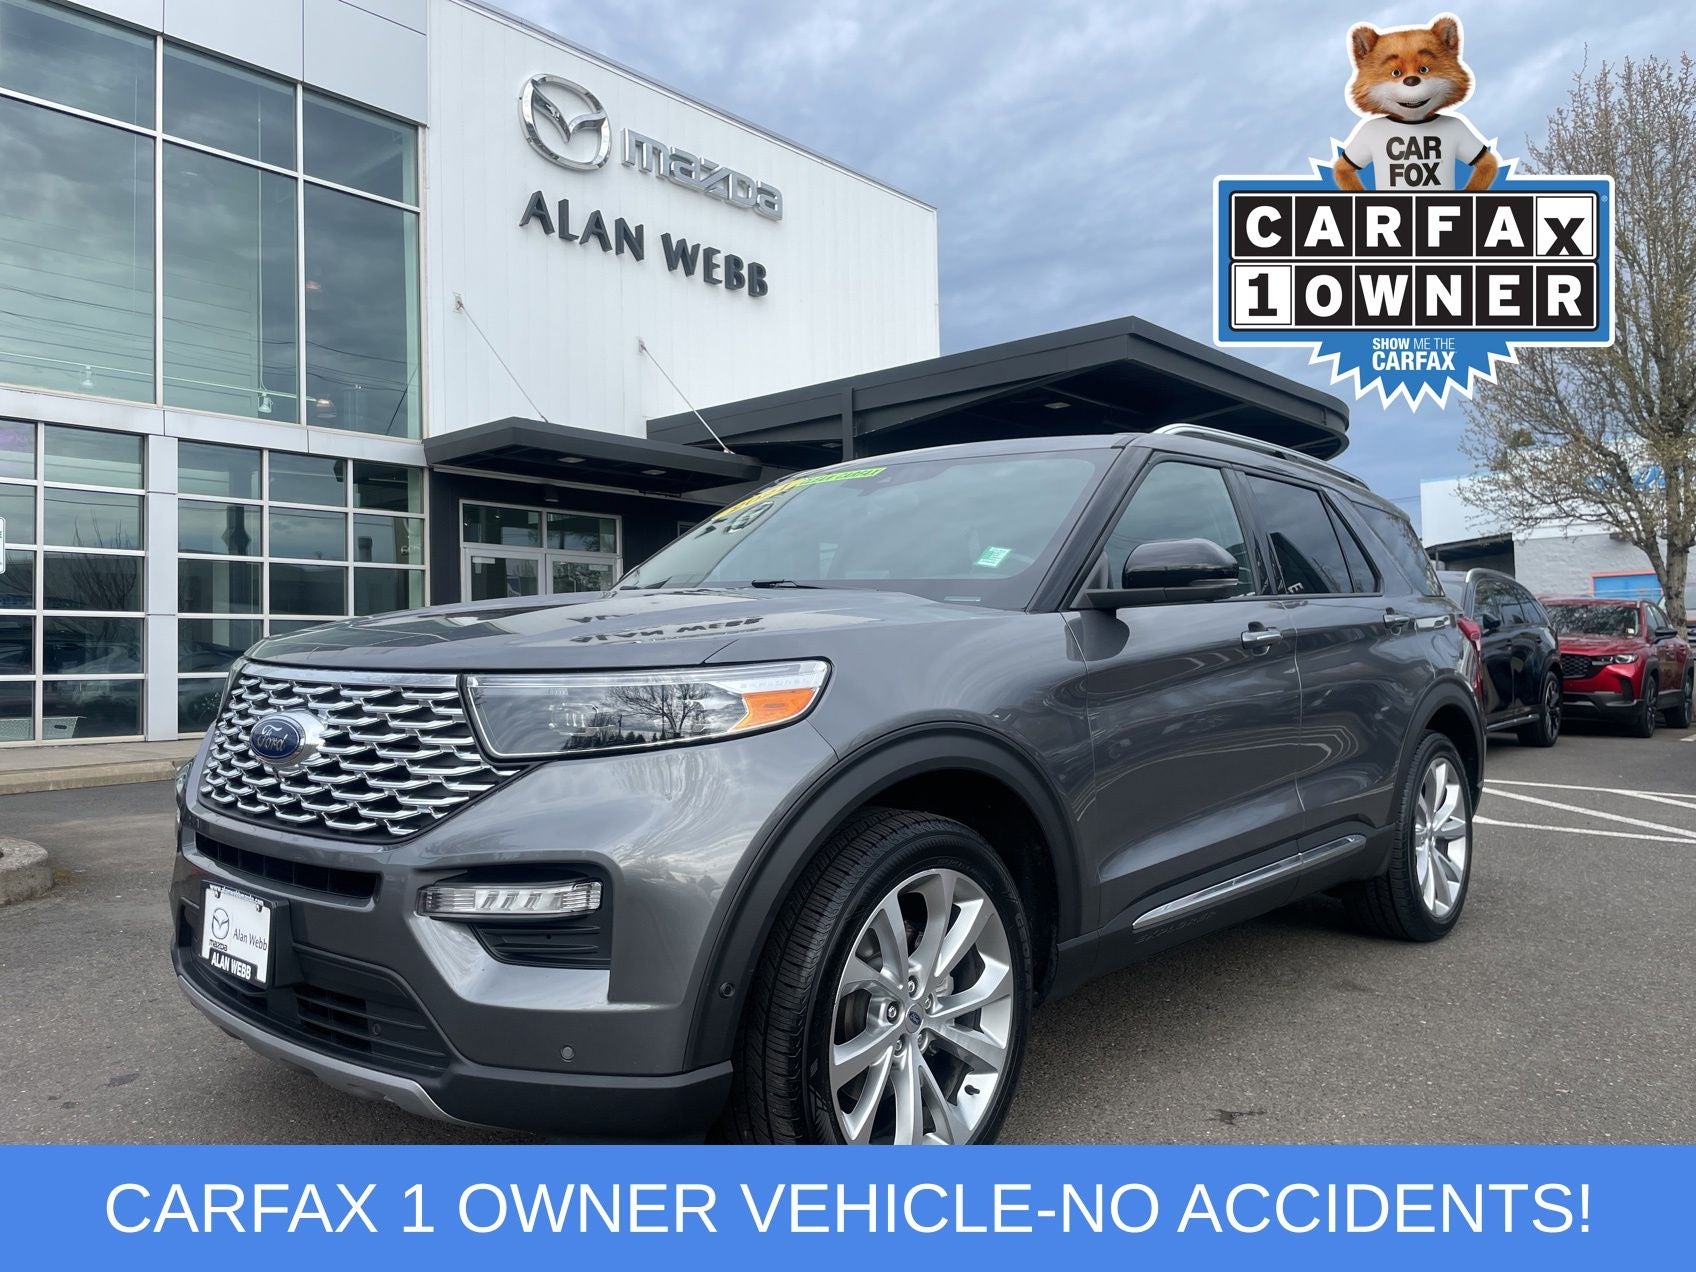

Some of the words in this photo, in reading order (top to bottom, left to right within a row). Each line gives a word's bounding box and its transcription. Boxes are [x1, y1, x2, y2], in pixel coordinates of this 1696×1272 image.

[620, 127, 783, 222] mazda
[519, 190, 644, 262] ALAN
[660, 232, 768, 298] WEBB
[257, 724, 288, 752] Ford
[232, 929, 247, 943] Alan
[249, 933, 267, 950] Webb
[211, 952, 230, 971] ALAN
[231, 959, 251, 979] WEBB
